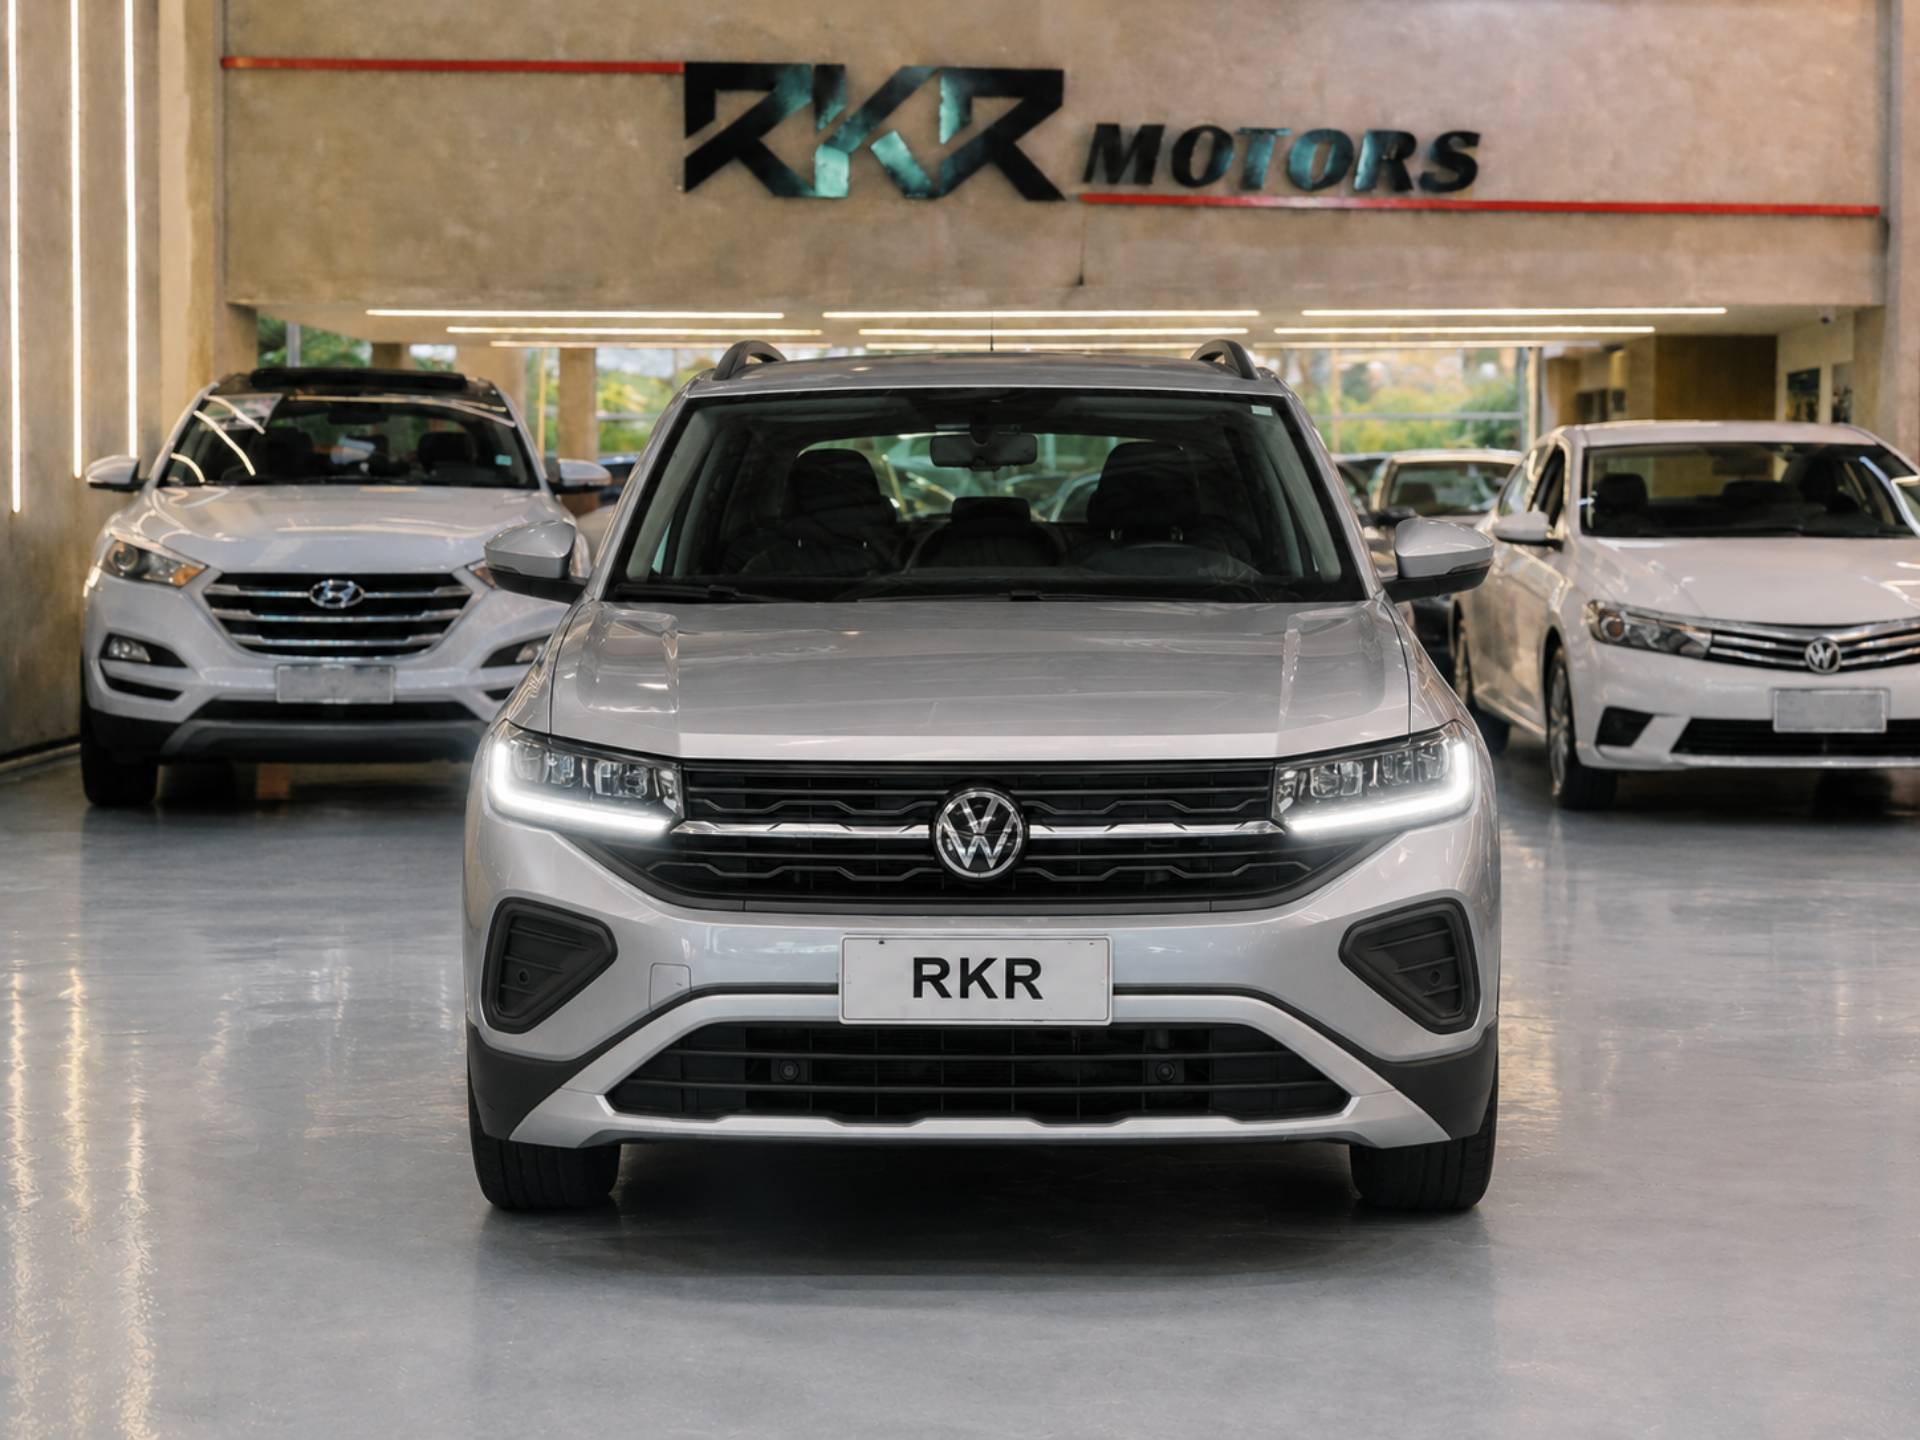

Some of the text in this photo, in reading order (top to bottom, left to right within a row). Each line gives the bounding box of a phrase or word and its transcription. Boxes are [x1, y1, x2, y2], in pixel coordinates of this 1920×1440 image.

[684, 63, 1481, 201] RKR MOTORS
[912, 957, 1043, 1000] RKR
